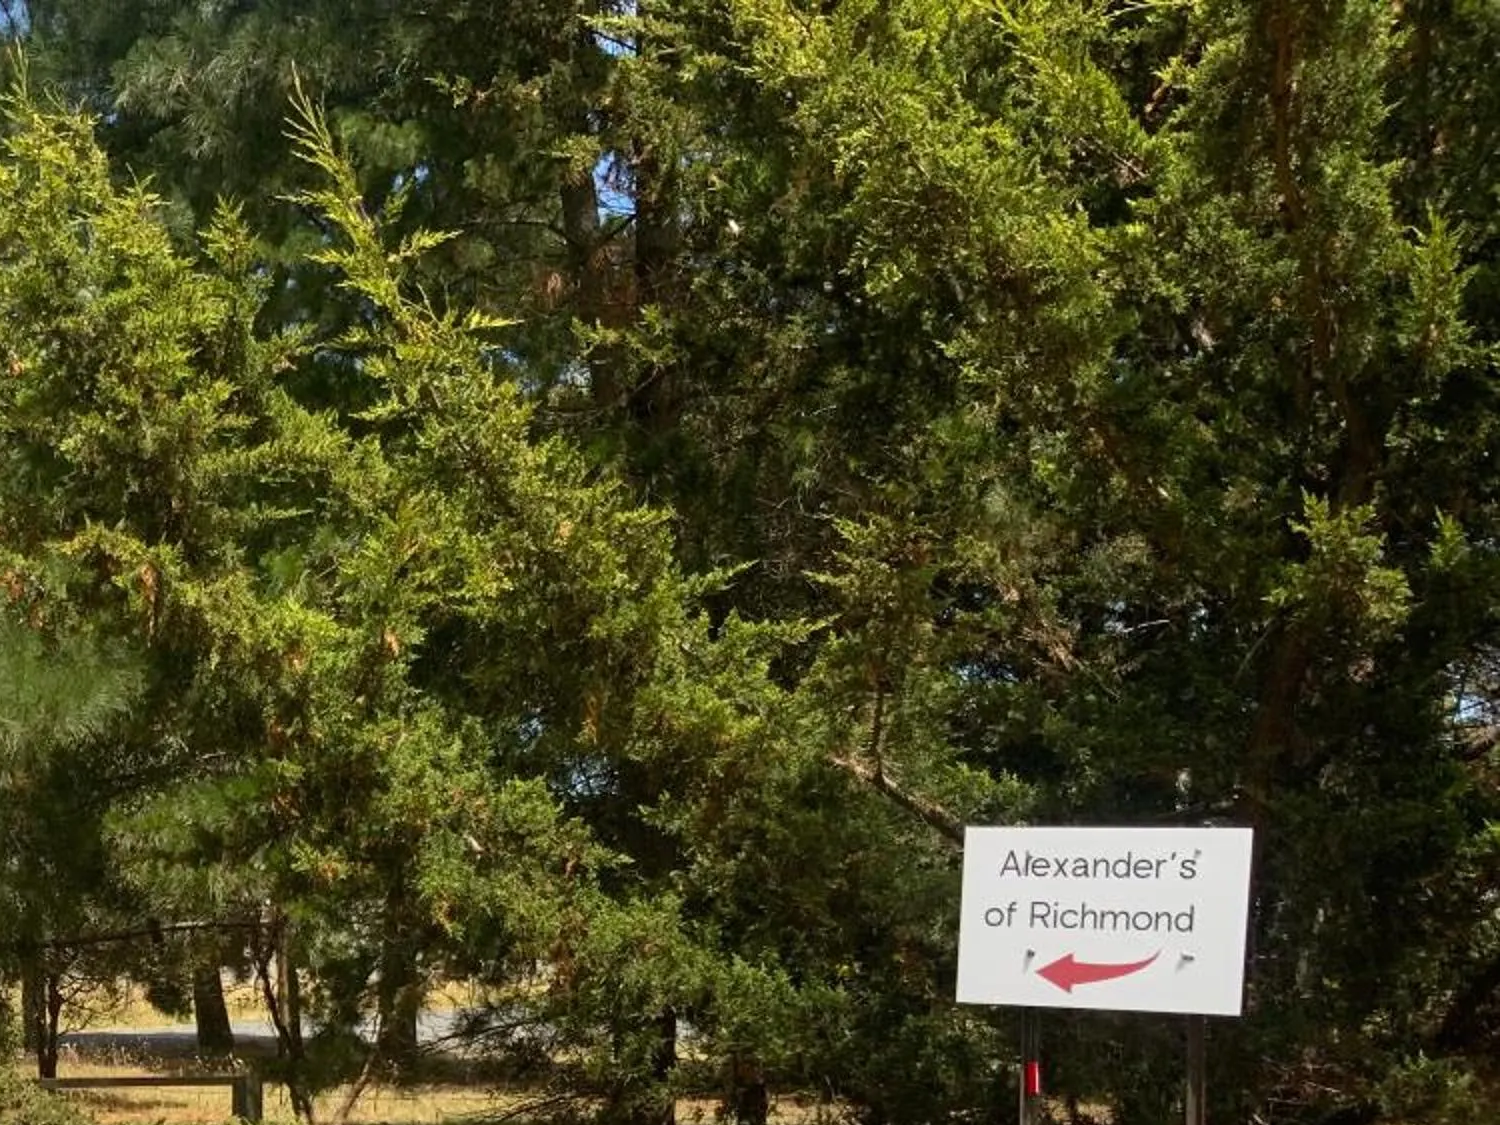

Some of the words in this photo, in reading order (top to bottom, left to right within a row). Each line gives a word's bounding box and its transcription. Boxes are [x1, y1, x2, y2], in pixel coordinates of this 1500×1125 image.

[999, 850, 1197, 880] Alexander's
[984, 902, 1017, 928] of
[1030, 901, 1195, 932] Richmond
